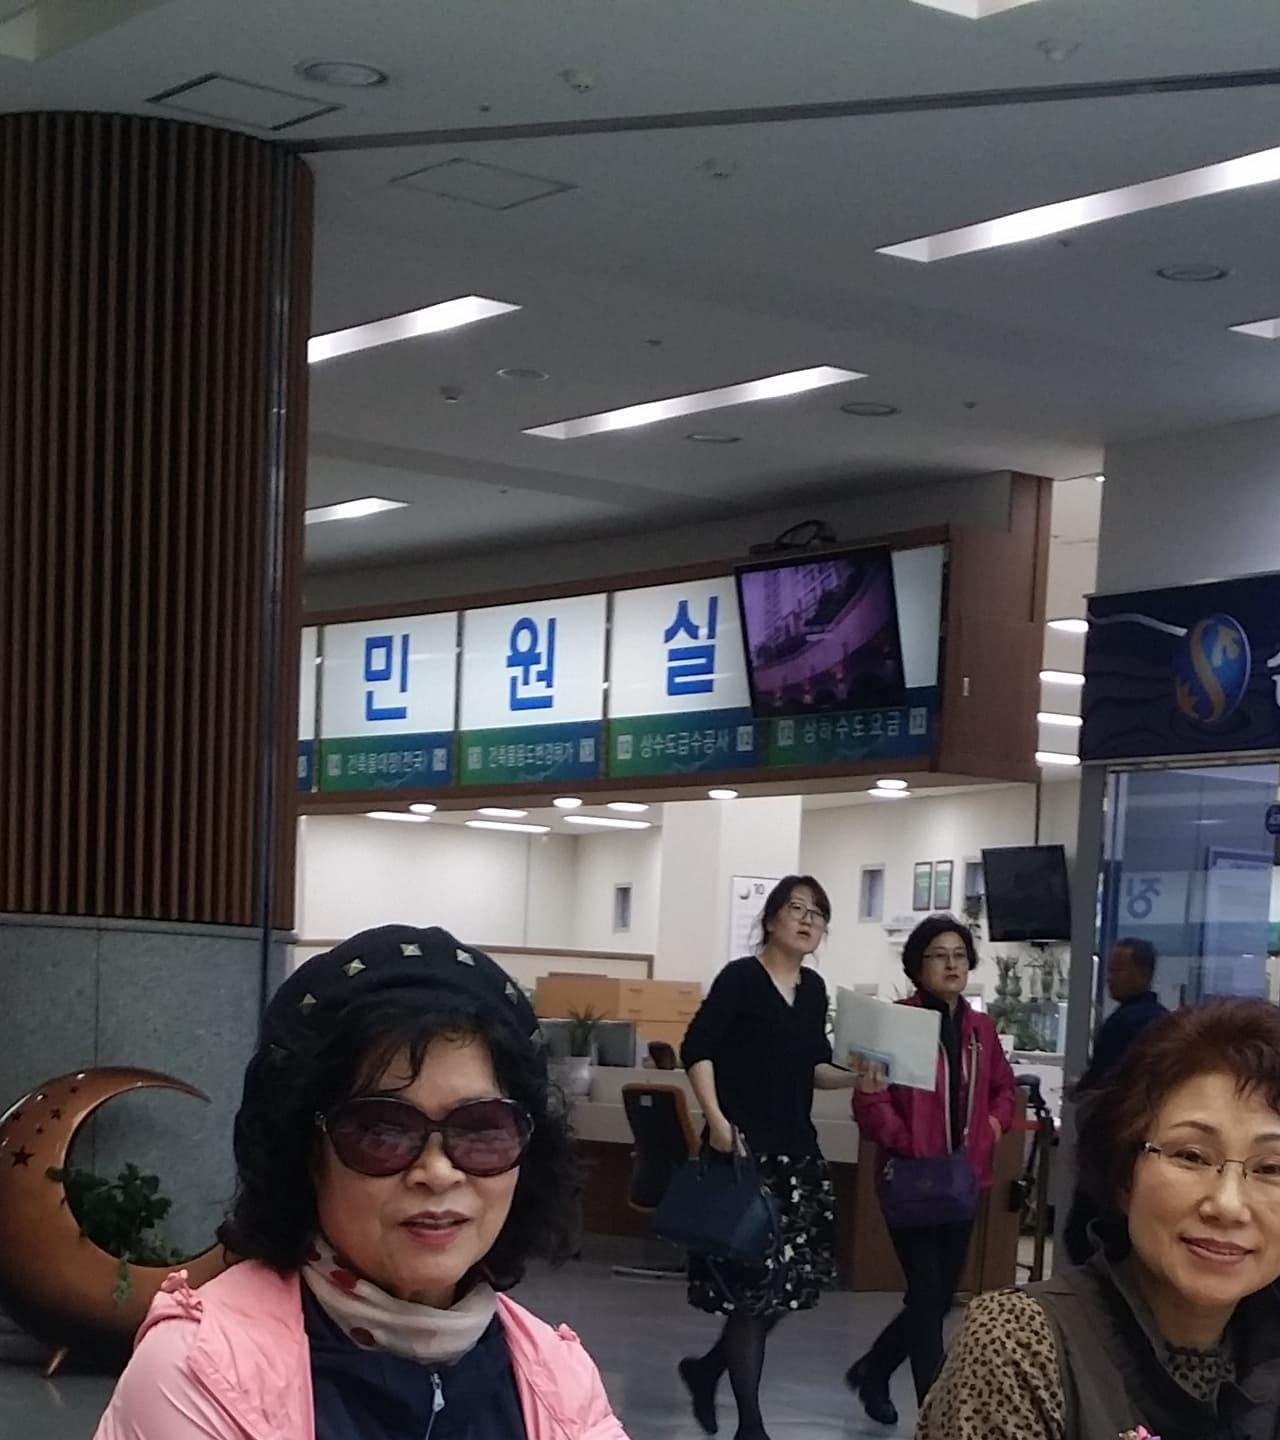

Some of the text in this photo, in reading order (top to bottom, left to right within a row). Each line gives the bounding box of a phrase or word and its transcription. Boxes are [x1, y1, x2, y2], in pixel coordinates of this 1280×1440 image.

[364, 595, 718, 722] 민 원 실
[801, 711, 900, 743] 상하수도요금
[640, 730, 729, 758] 상수도급수공사
